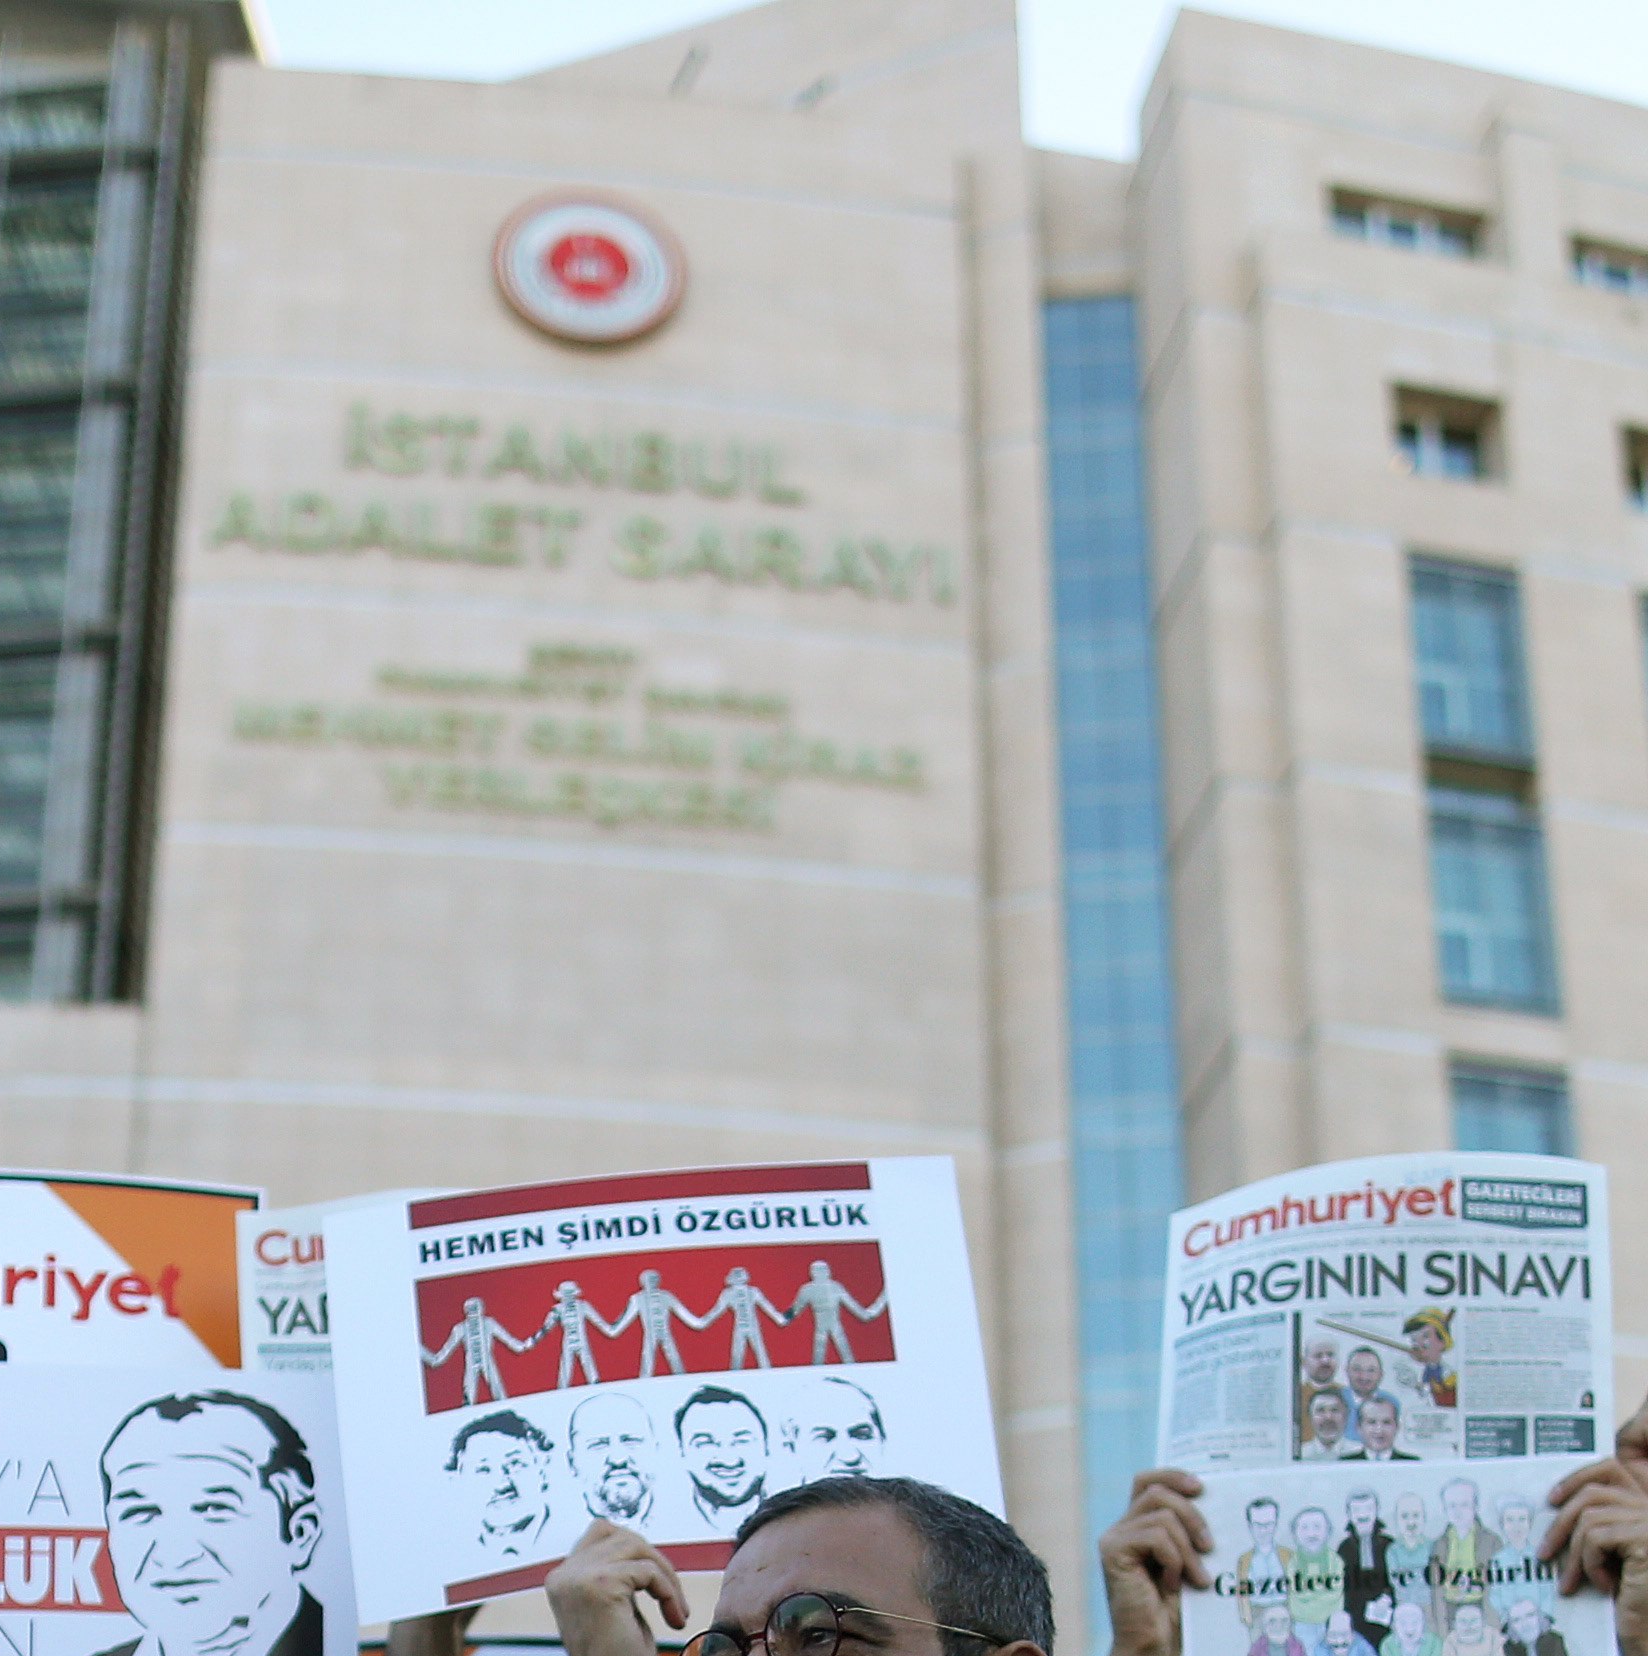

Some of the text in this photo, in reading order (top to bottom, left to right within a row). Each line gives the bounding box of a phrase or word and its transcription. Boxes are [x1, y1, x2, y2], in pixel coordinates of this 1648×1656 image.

[344, 400, 806, 506] İSTANBUL
[208, 490, 959, 606] ADALET SARAYI
[420, 1200, 868, 1263] HEMEN ŞİMDİ ÖZGÜRLÜK
[1183, 1178, 1456, 1258] Cumhuriyet
[1180, 1251, 1591, 1324] YARGININ SINAVI
